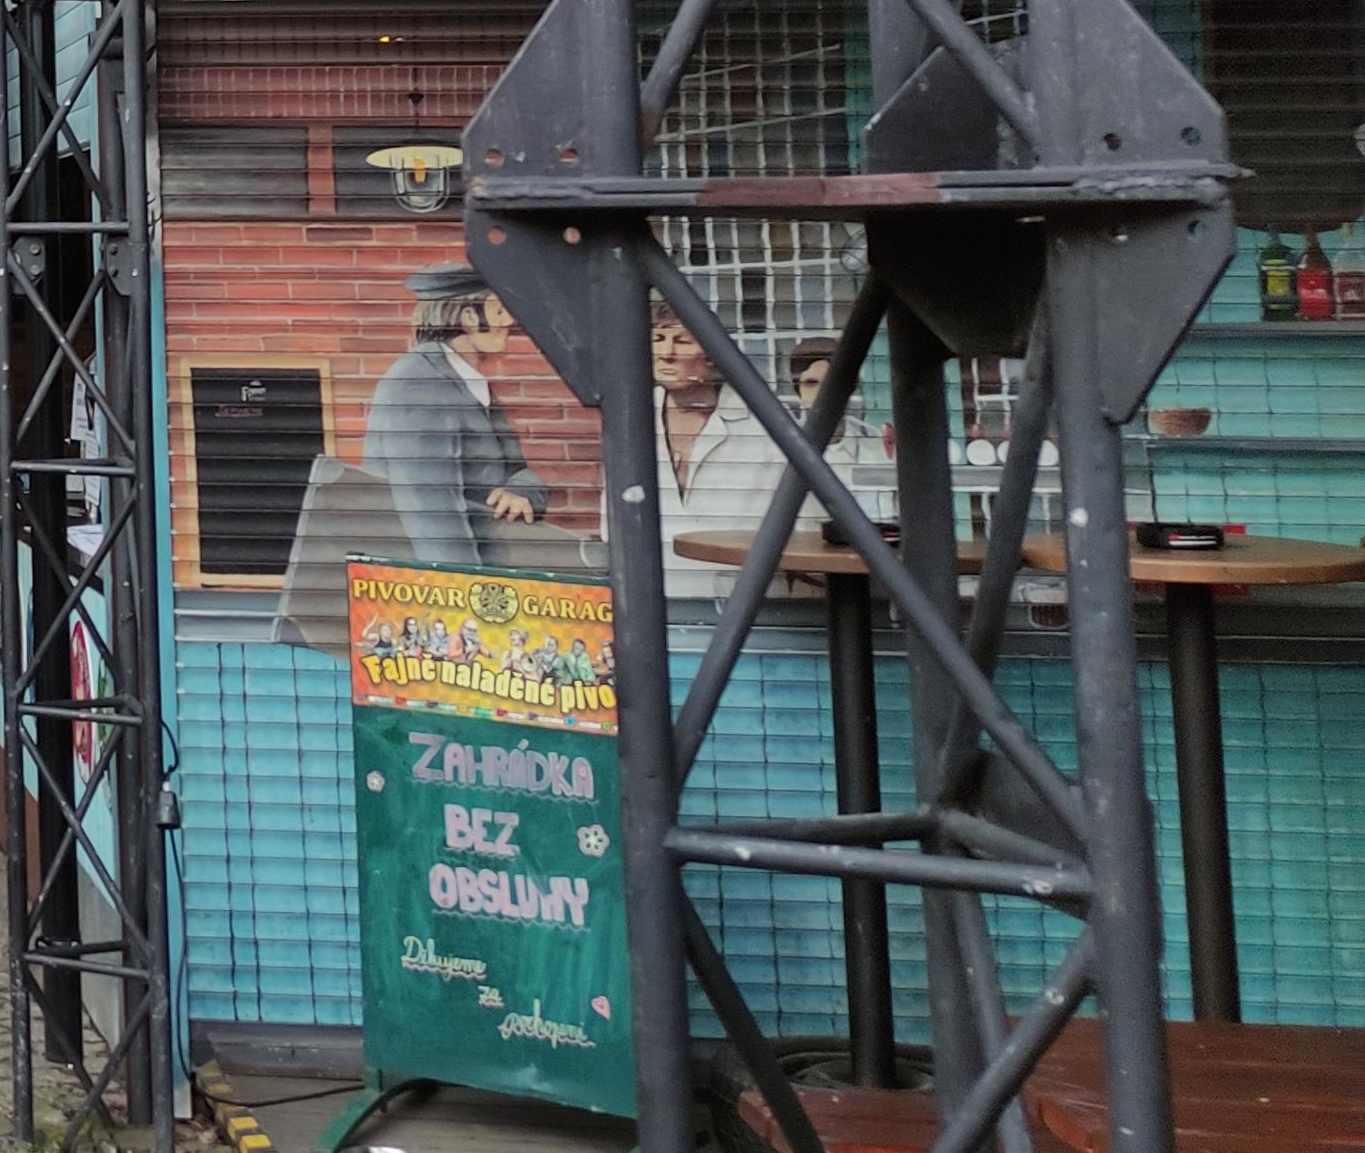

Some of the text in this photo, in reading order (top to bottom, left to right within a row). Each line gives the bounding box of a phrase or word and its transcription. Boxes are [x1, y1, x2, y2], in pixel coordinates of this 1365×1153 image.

[352, 578, 613, 623] PIVOVAR GARAG
[409, 731, 595, 799] ZAHRÁDKA
[444, 802, 519, 855] BEZ
